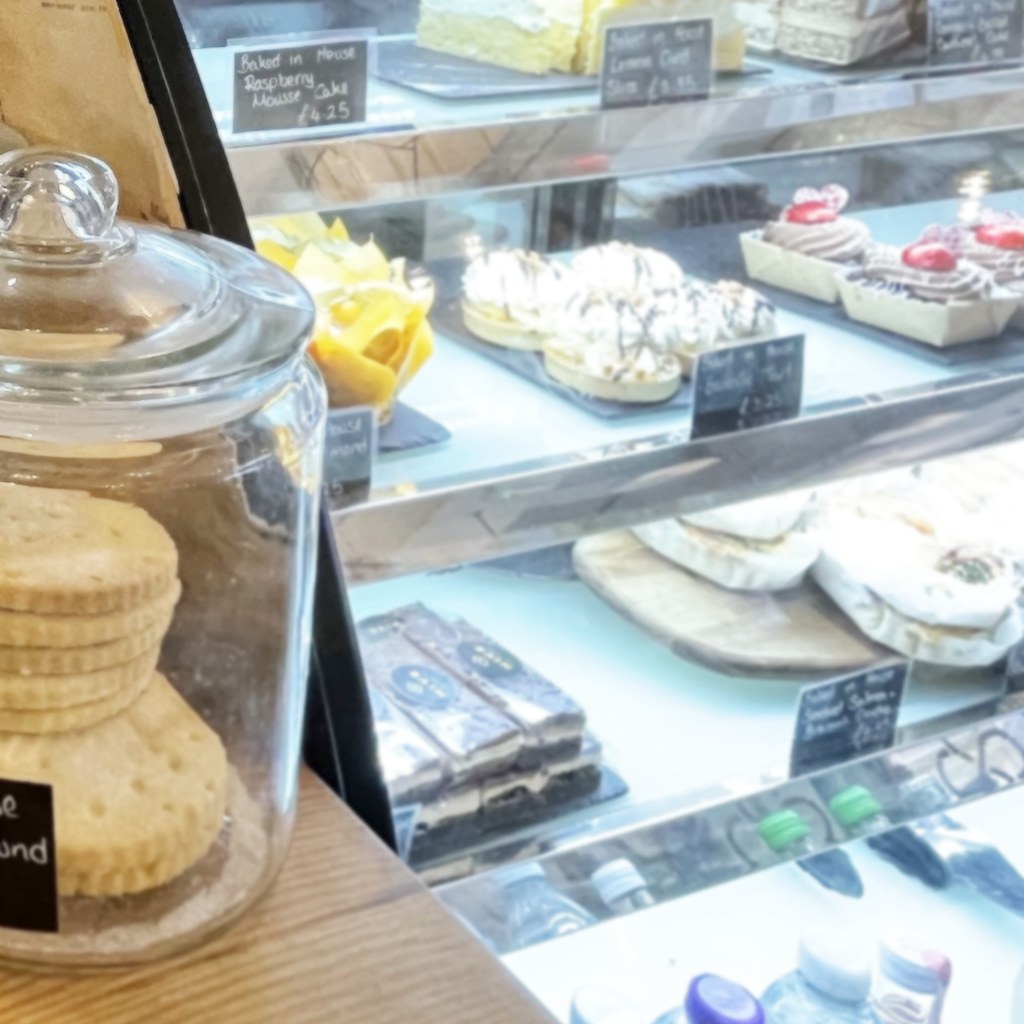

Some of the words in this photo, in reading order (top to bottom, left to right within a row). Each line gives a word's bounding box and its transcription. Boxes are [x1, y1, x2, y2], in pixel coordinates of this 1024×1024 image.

[238, 53, 281, 74] Baked
[289, 54, 303, 66] in
[316, 46, 356, 63] House
[244, 72, 315, 93] Raspberry
[252, 89, 301, 109] Mousse
[314, 80, 349, 100] Cake
